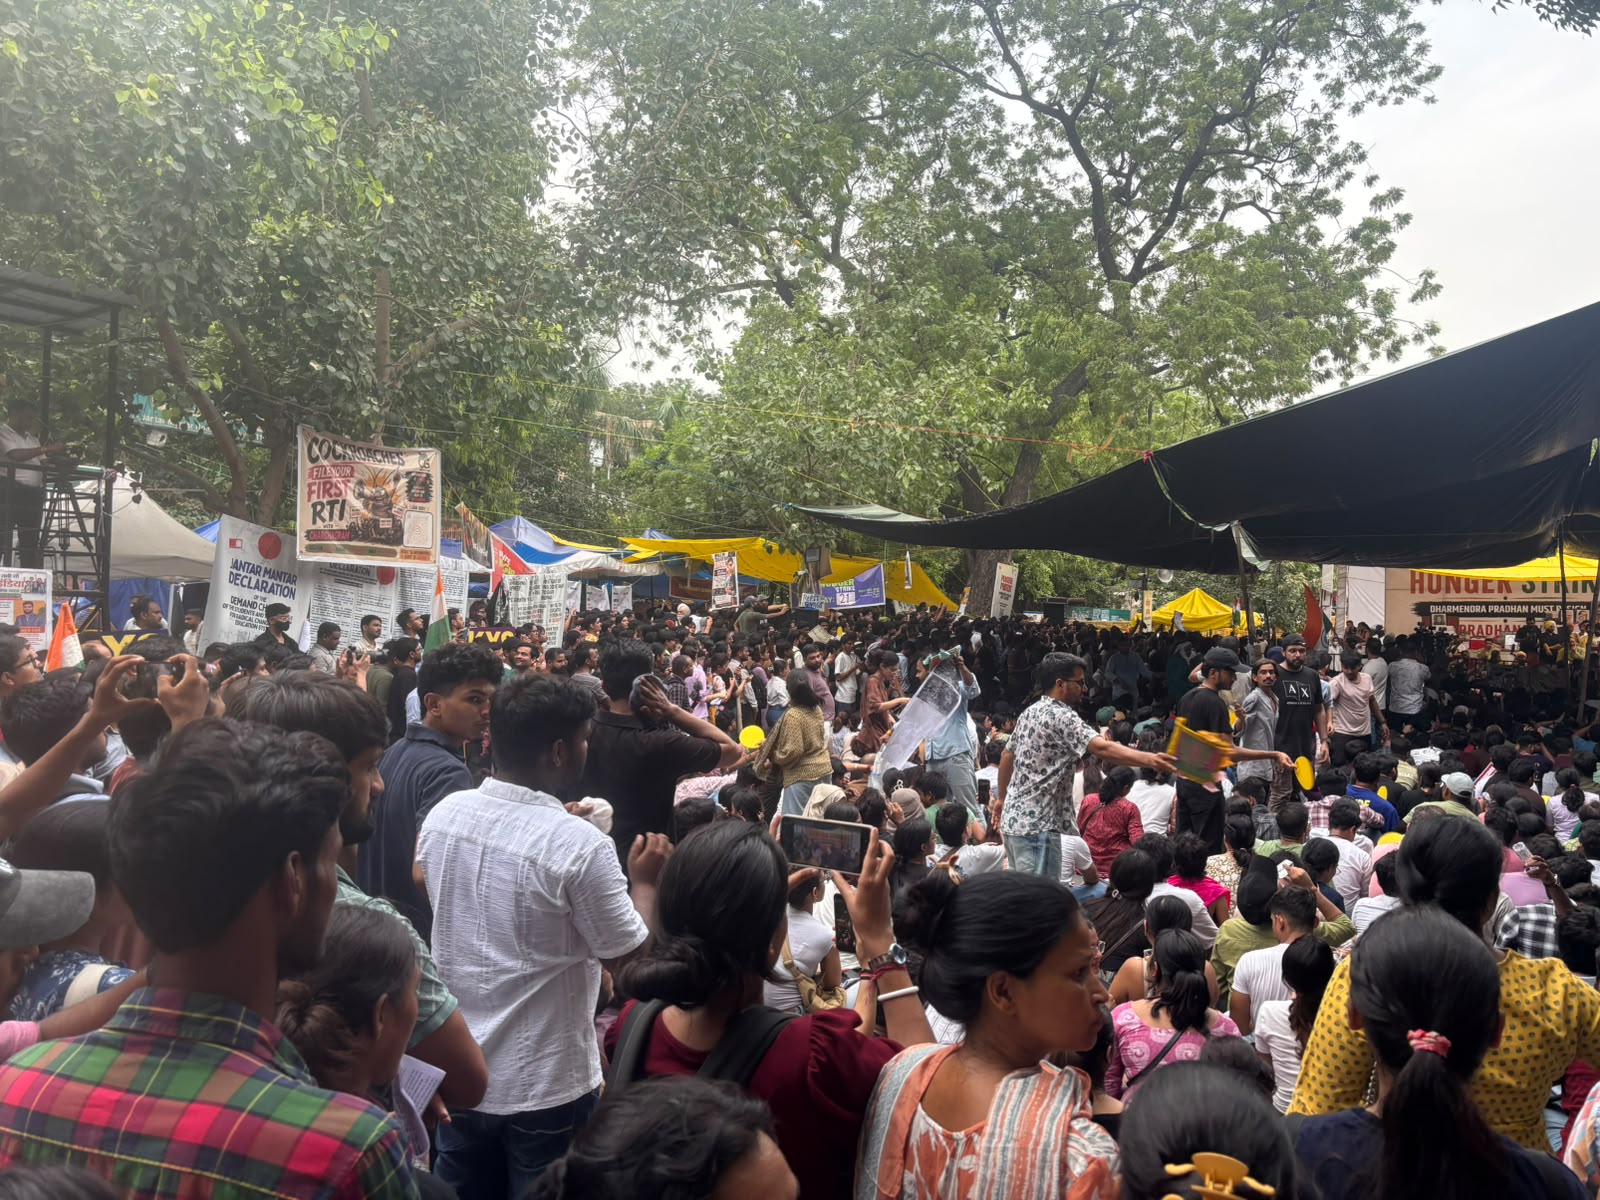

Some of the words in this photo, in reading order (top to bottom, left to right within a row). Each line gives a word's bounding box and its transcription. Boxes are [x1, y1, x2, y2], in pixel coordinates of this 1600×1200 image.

[307, 436, 405, 466] COCKROACHES
[313, 467, 332, 478] FILE
[307, 479, 351, 502] FIRST
[311, 500, 347, 525] RTI
[230, 558, 262, 577] JANTAR
[263, 566, 298, 586] MANTAR
[228, 571, 297, 600] DECLARATION
[230, 595, 258, 610] DEMAND
[839, 593, 850, 604] 21
[1430, 605, 1487, 613] DHARMENDRA
[1488, 605, 1529, 613] PRADHAN
[1530, 605, 1555, 613] MUST
